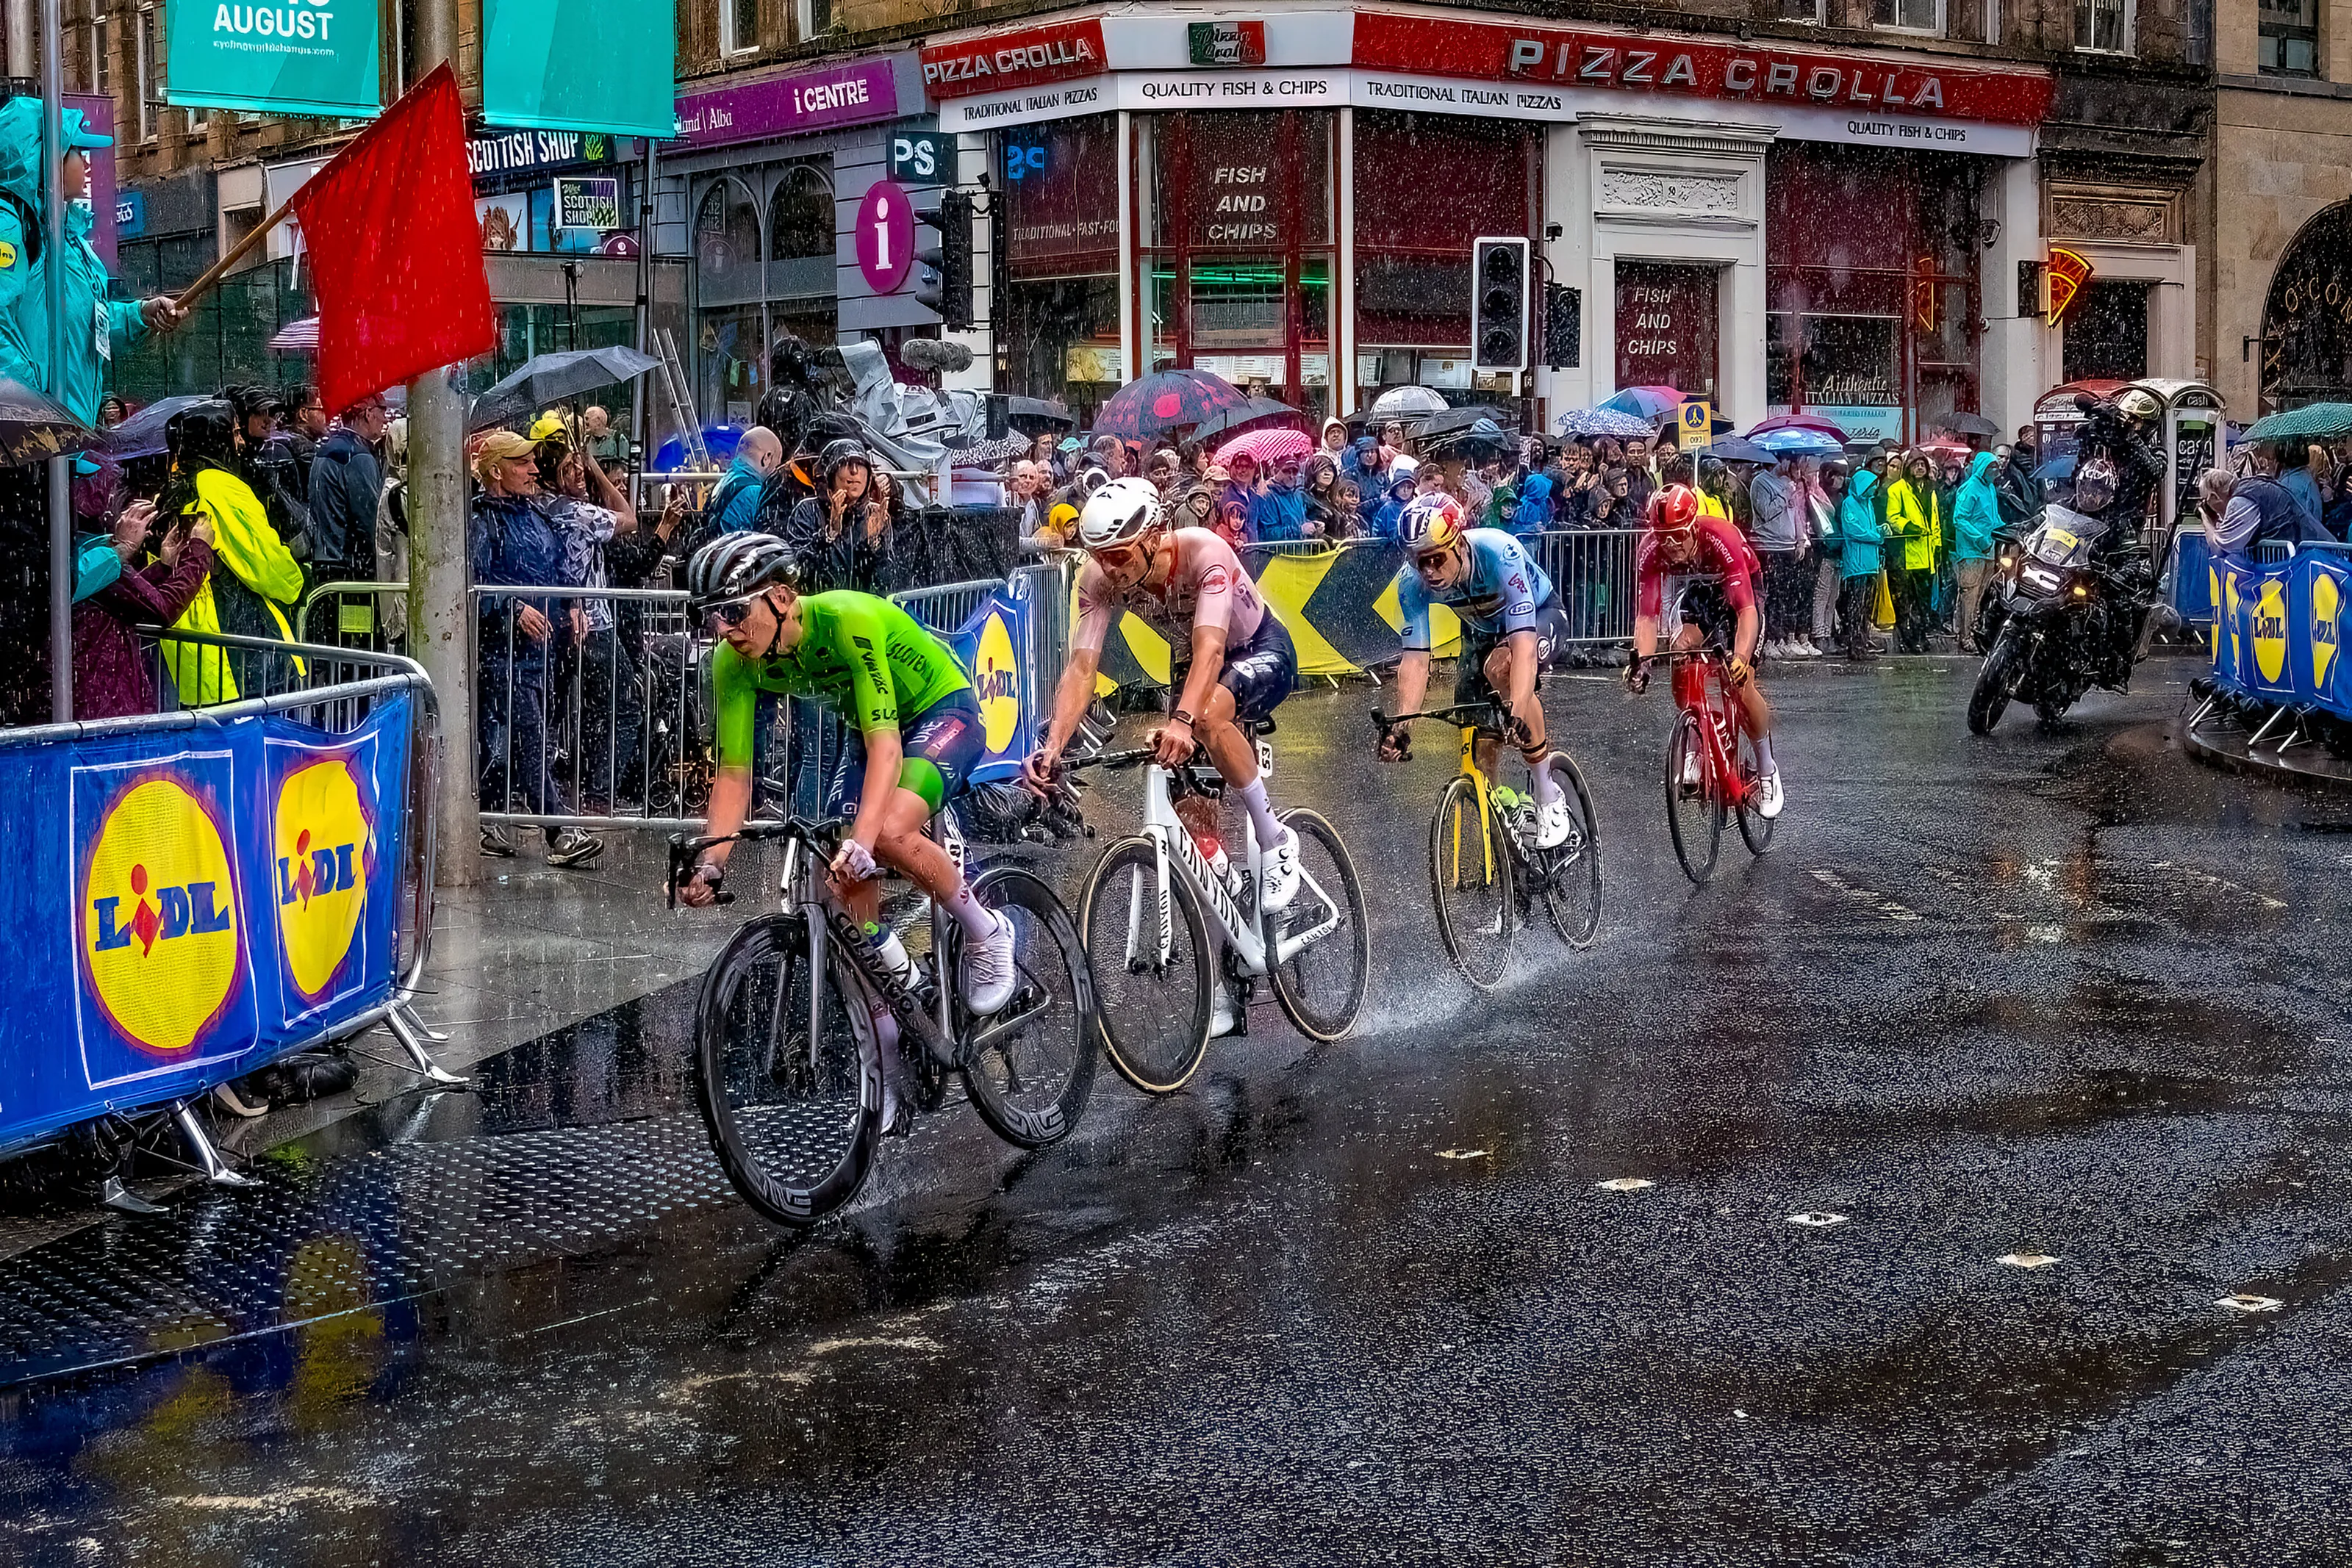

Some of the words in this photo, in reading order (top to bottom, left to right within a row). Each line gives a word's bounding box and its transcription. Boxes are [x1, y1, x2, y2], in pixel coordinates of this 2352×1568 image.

[213, 4, 333, 40] AUGUST
[924, 54, 990, 85] PIZZA
[995, 37, 1094, 73] CROLLA
[1510, 39, 1698, 86] PIZZA
[1725, 59, 1944, 108] CROLLA
[794, 87, 803, 115] i
[803, 79, 870, 112] CENTRE
[1141, 82, 1213, 98] QUALITY
[1222, 81, 1256, 96] FISH
[1262, 82, 1274, 96] &
[1278, 80, 1327, 96] CHIPS
[1366, 81, 1456, 103] TRADITIONAL
[1460, 88, 1510, 106] ITALIAN
[1516, 93, 1563, 110] PIZZAS
[964, 99, 1022, 121] TRADITIONAL
[1026, 94, 1060, 110] ITALIAN
[1064, 87, 1098, 106] PIZZAS
[709, 107, 733, 130] Alba
[1846, 121, 1895, 136] QUALITY
[1899, 124, 1921, 138] FISH
[1924, 127, 1933, 139] &
[1935, 126, 1966, 142] CHIPS
[465, 132, 535, 174] SCOTTISH
[538, 130, 578, 163] SHOP
[894, 138, 935, 176] PS
[1213, 167, 1266, 184] FISH
[564, 195, 614, 209] SCOTTISH
[1216, 195, 1266, 213] AND
[1014, 223, 1072, 241] TRADITIONAL
[1208, 223, 1277, 240] CHIPS
[1633, 287, 1672, 305] FISH
[1635, 314, 1671, 330] AND
[1627, 339, 1677, 356] CHIPS
[1823, 367, 1887, 393] Authentic
[1805, 392, 1852, 404] ITALIAN
[1858, 392, 1899, 405] PIZZAS
[2187, 394, 2209, 406] cash
[1179, 826, 1240, 940] CANYON
